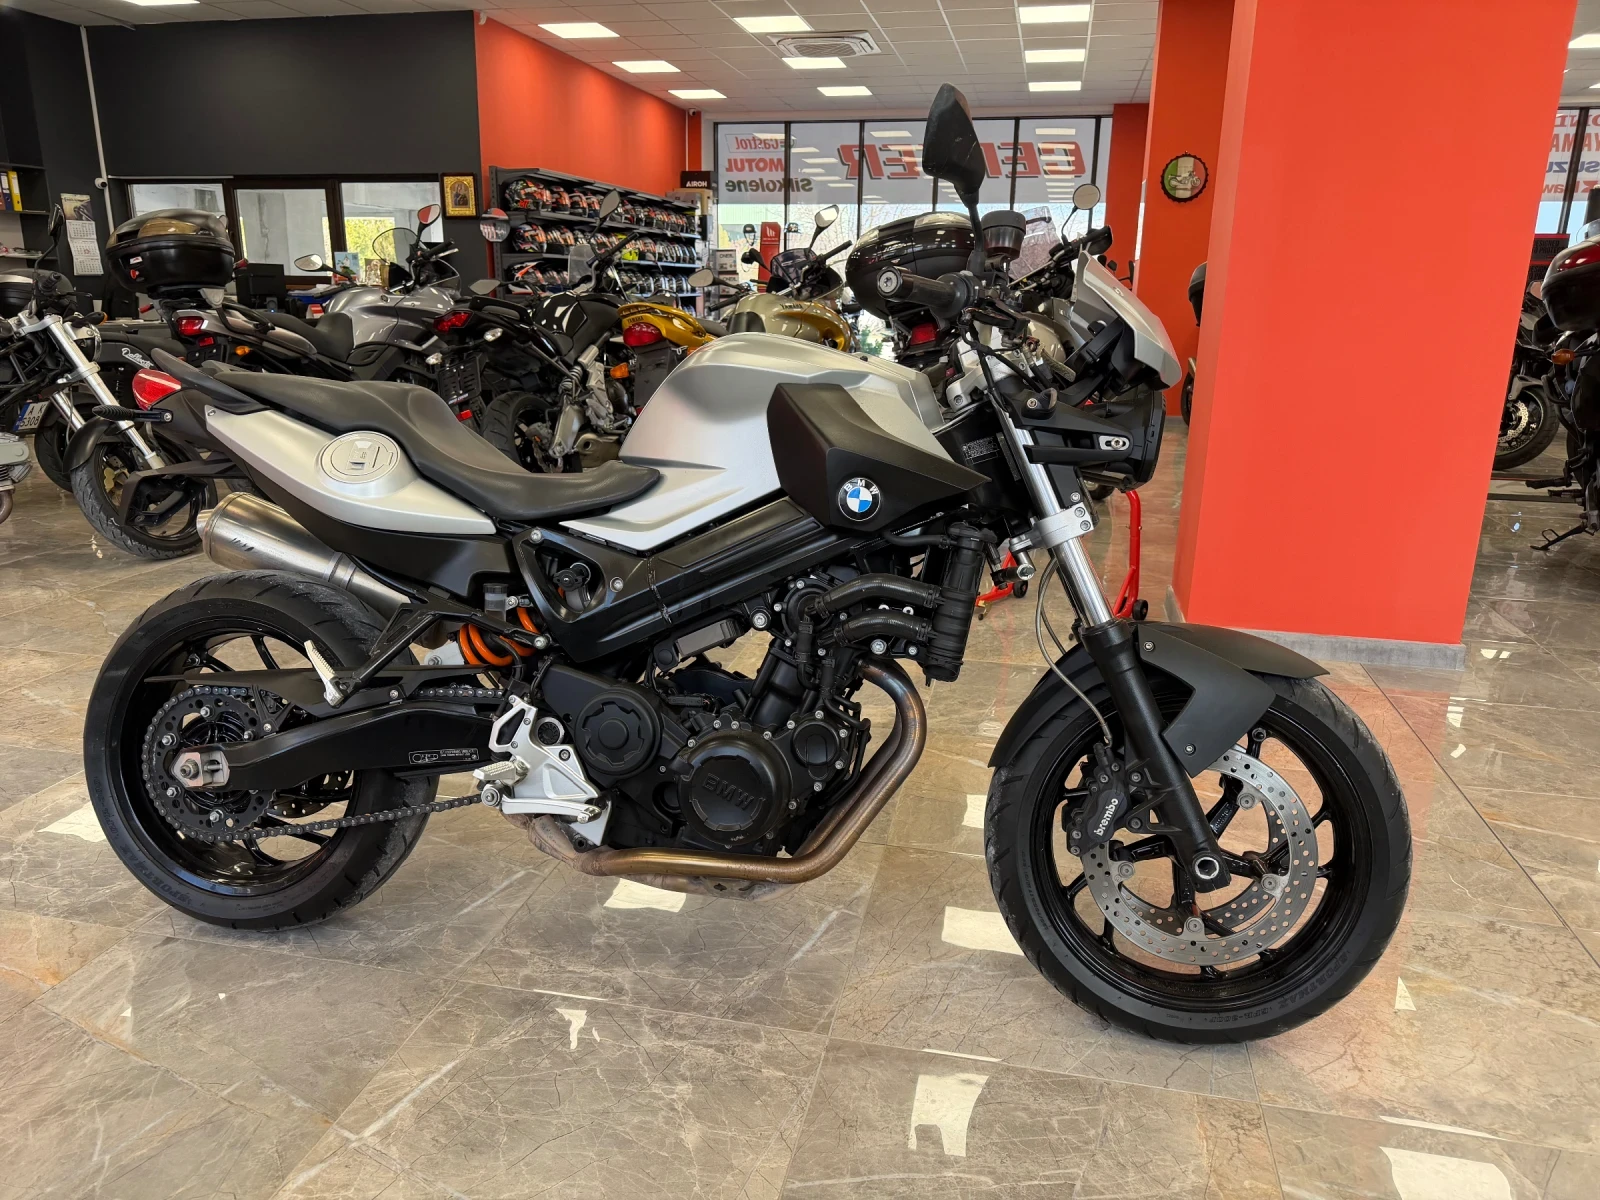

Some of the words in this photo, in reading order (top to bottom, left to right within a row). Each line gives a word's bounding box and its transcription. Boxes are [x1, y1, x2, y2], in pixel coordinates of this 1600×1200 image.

[844, 479, 880, 495] BMW
[702, 773, 755, 811] BMW
[1093, 798, 1119, 837] brembo
[1277, 952, 1350, 1010] SPORTMAX
